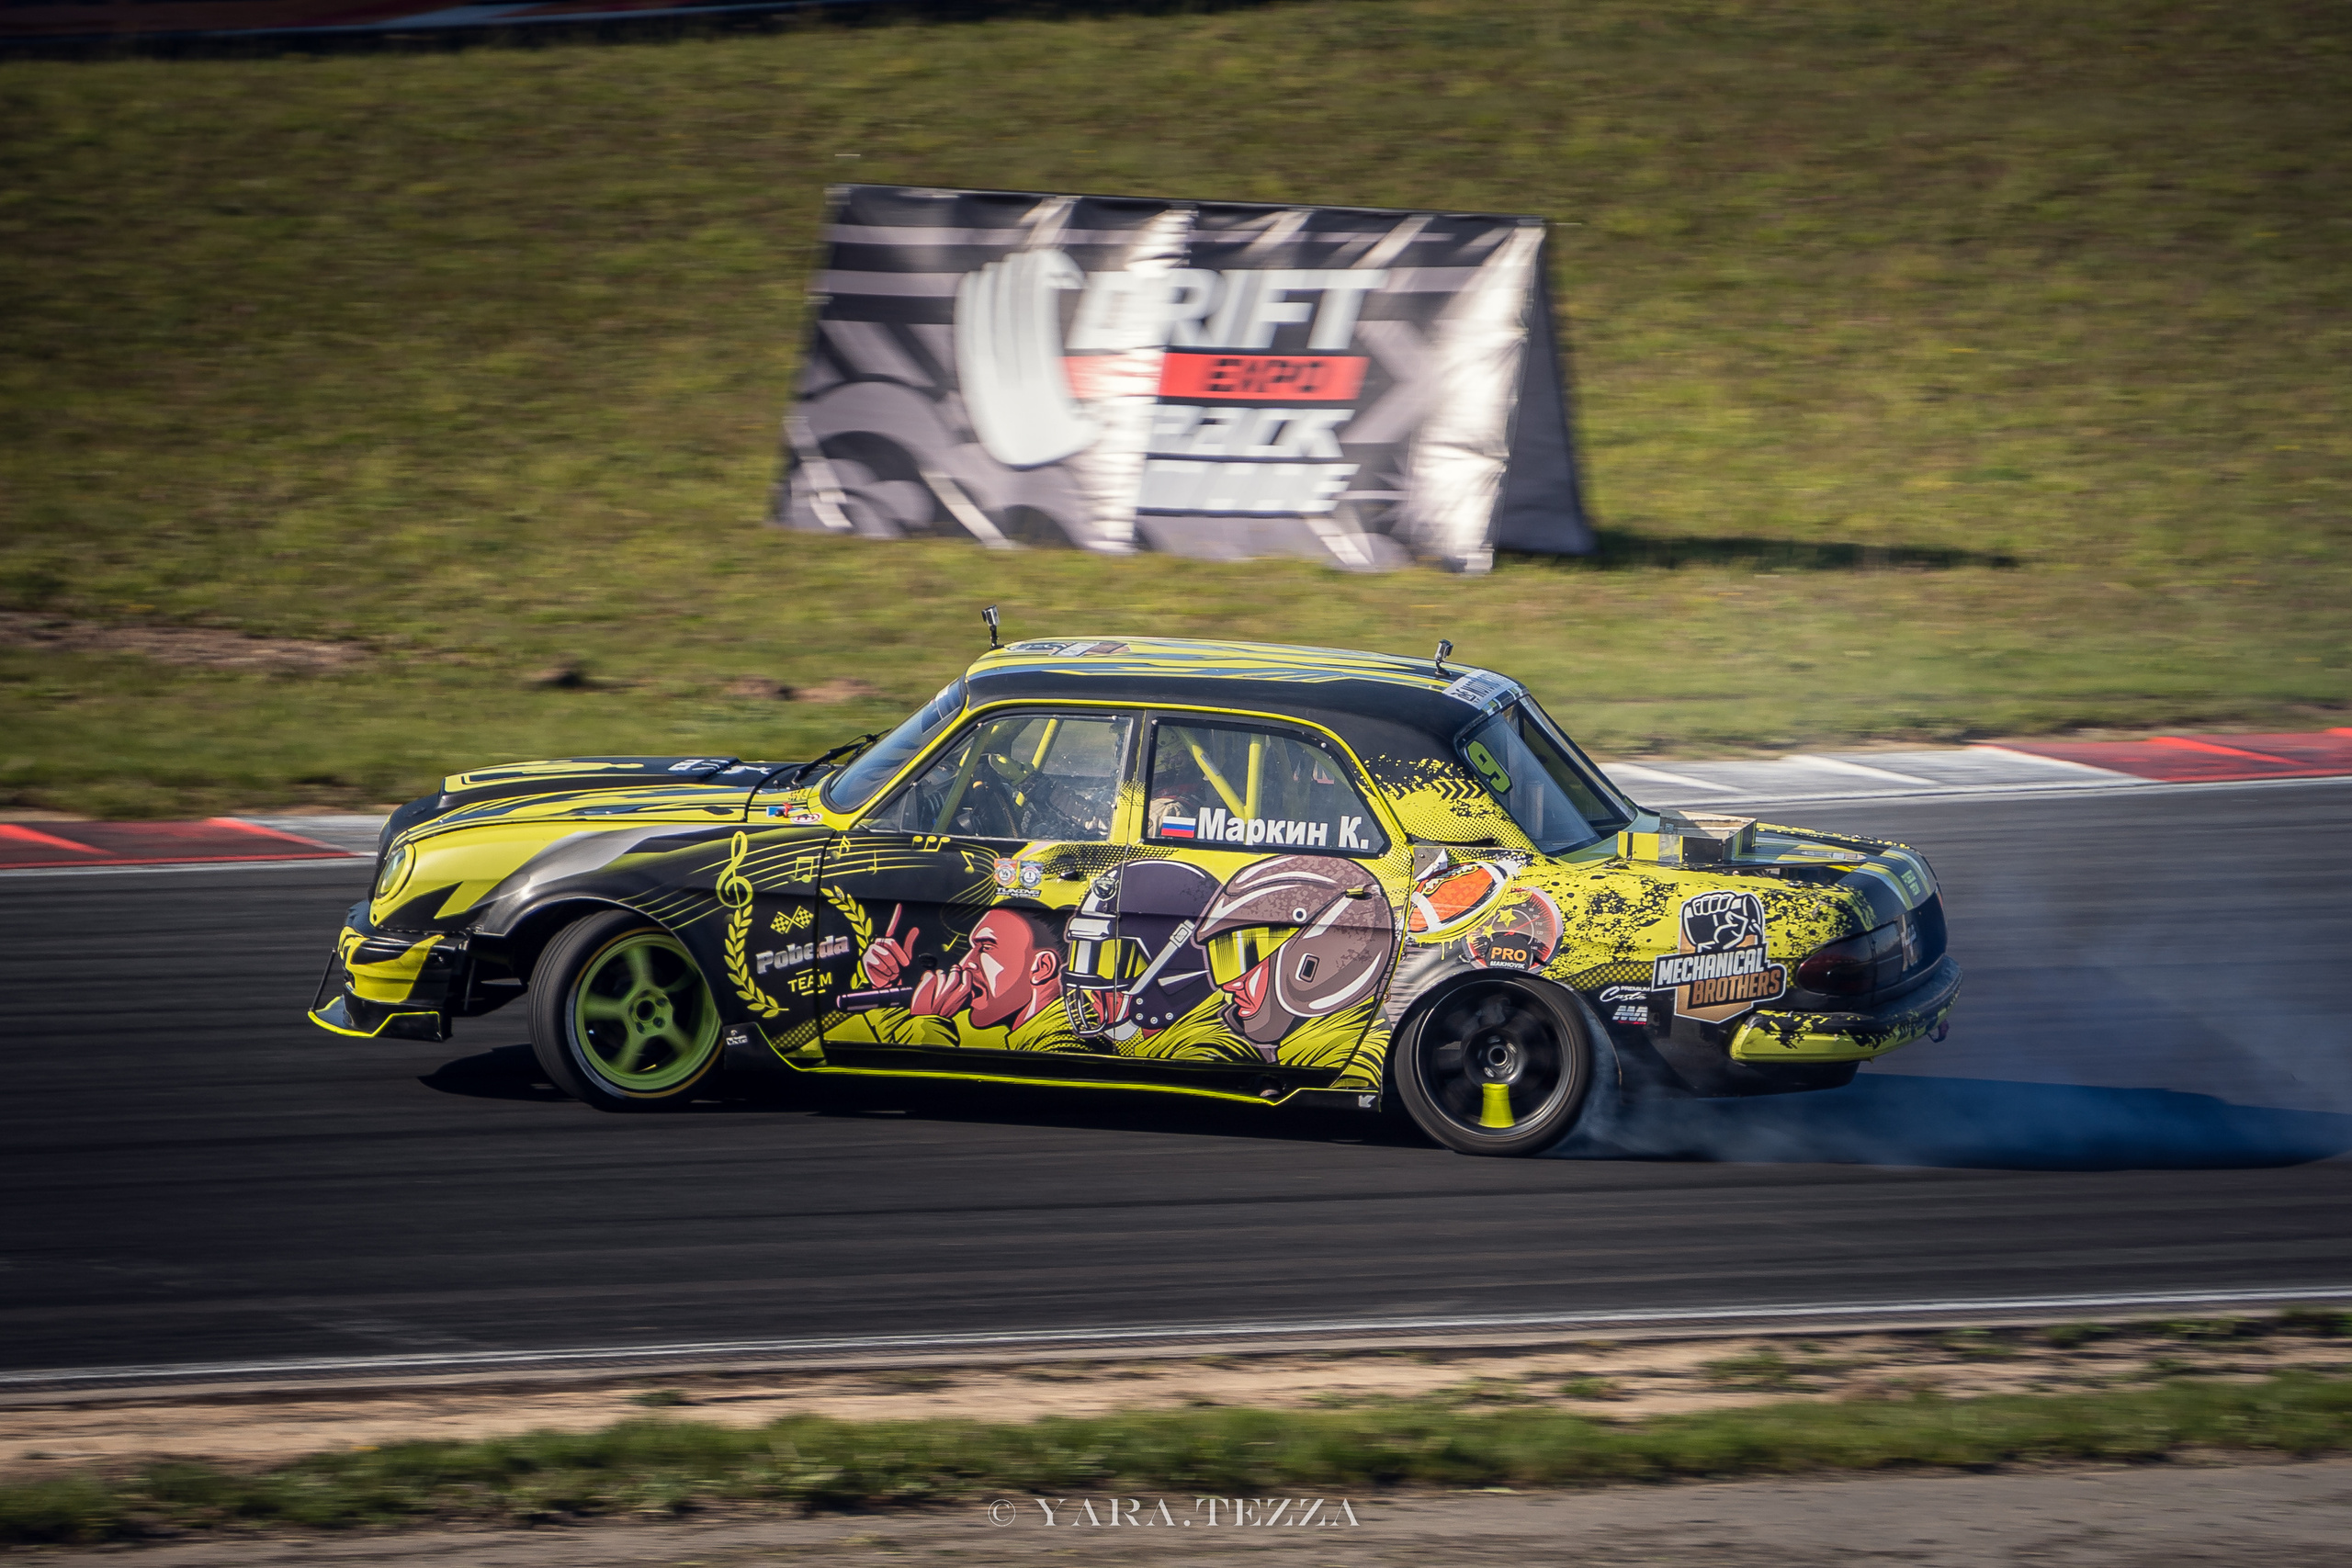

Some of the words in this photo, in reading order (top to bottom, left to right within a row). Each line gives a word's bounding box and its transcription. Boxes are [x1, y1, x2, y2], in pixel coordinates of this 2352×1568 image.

[1064, 267, 1387, 350] DRIFT
[1467, 740, 1510, 794] 9
[1197, 807, 1329, 846] Маркин
[1338, 815, 1370, 850] К.
[755, 935, 850, 975] Pobeda
[1489, 961, 1526, 969] MAKHOVIK
[1490, 946, 1528, 963] PRO
[1657, 947, 1765, 986] MECHANICAL
[787, 972, 832, 993] TEAM
[1691, 968, 1781, 1006] BROTHERS
